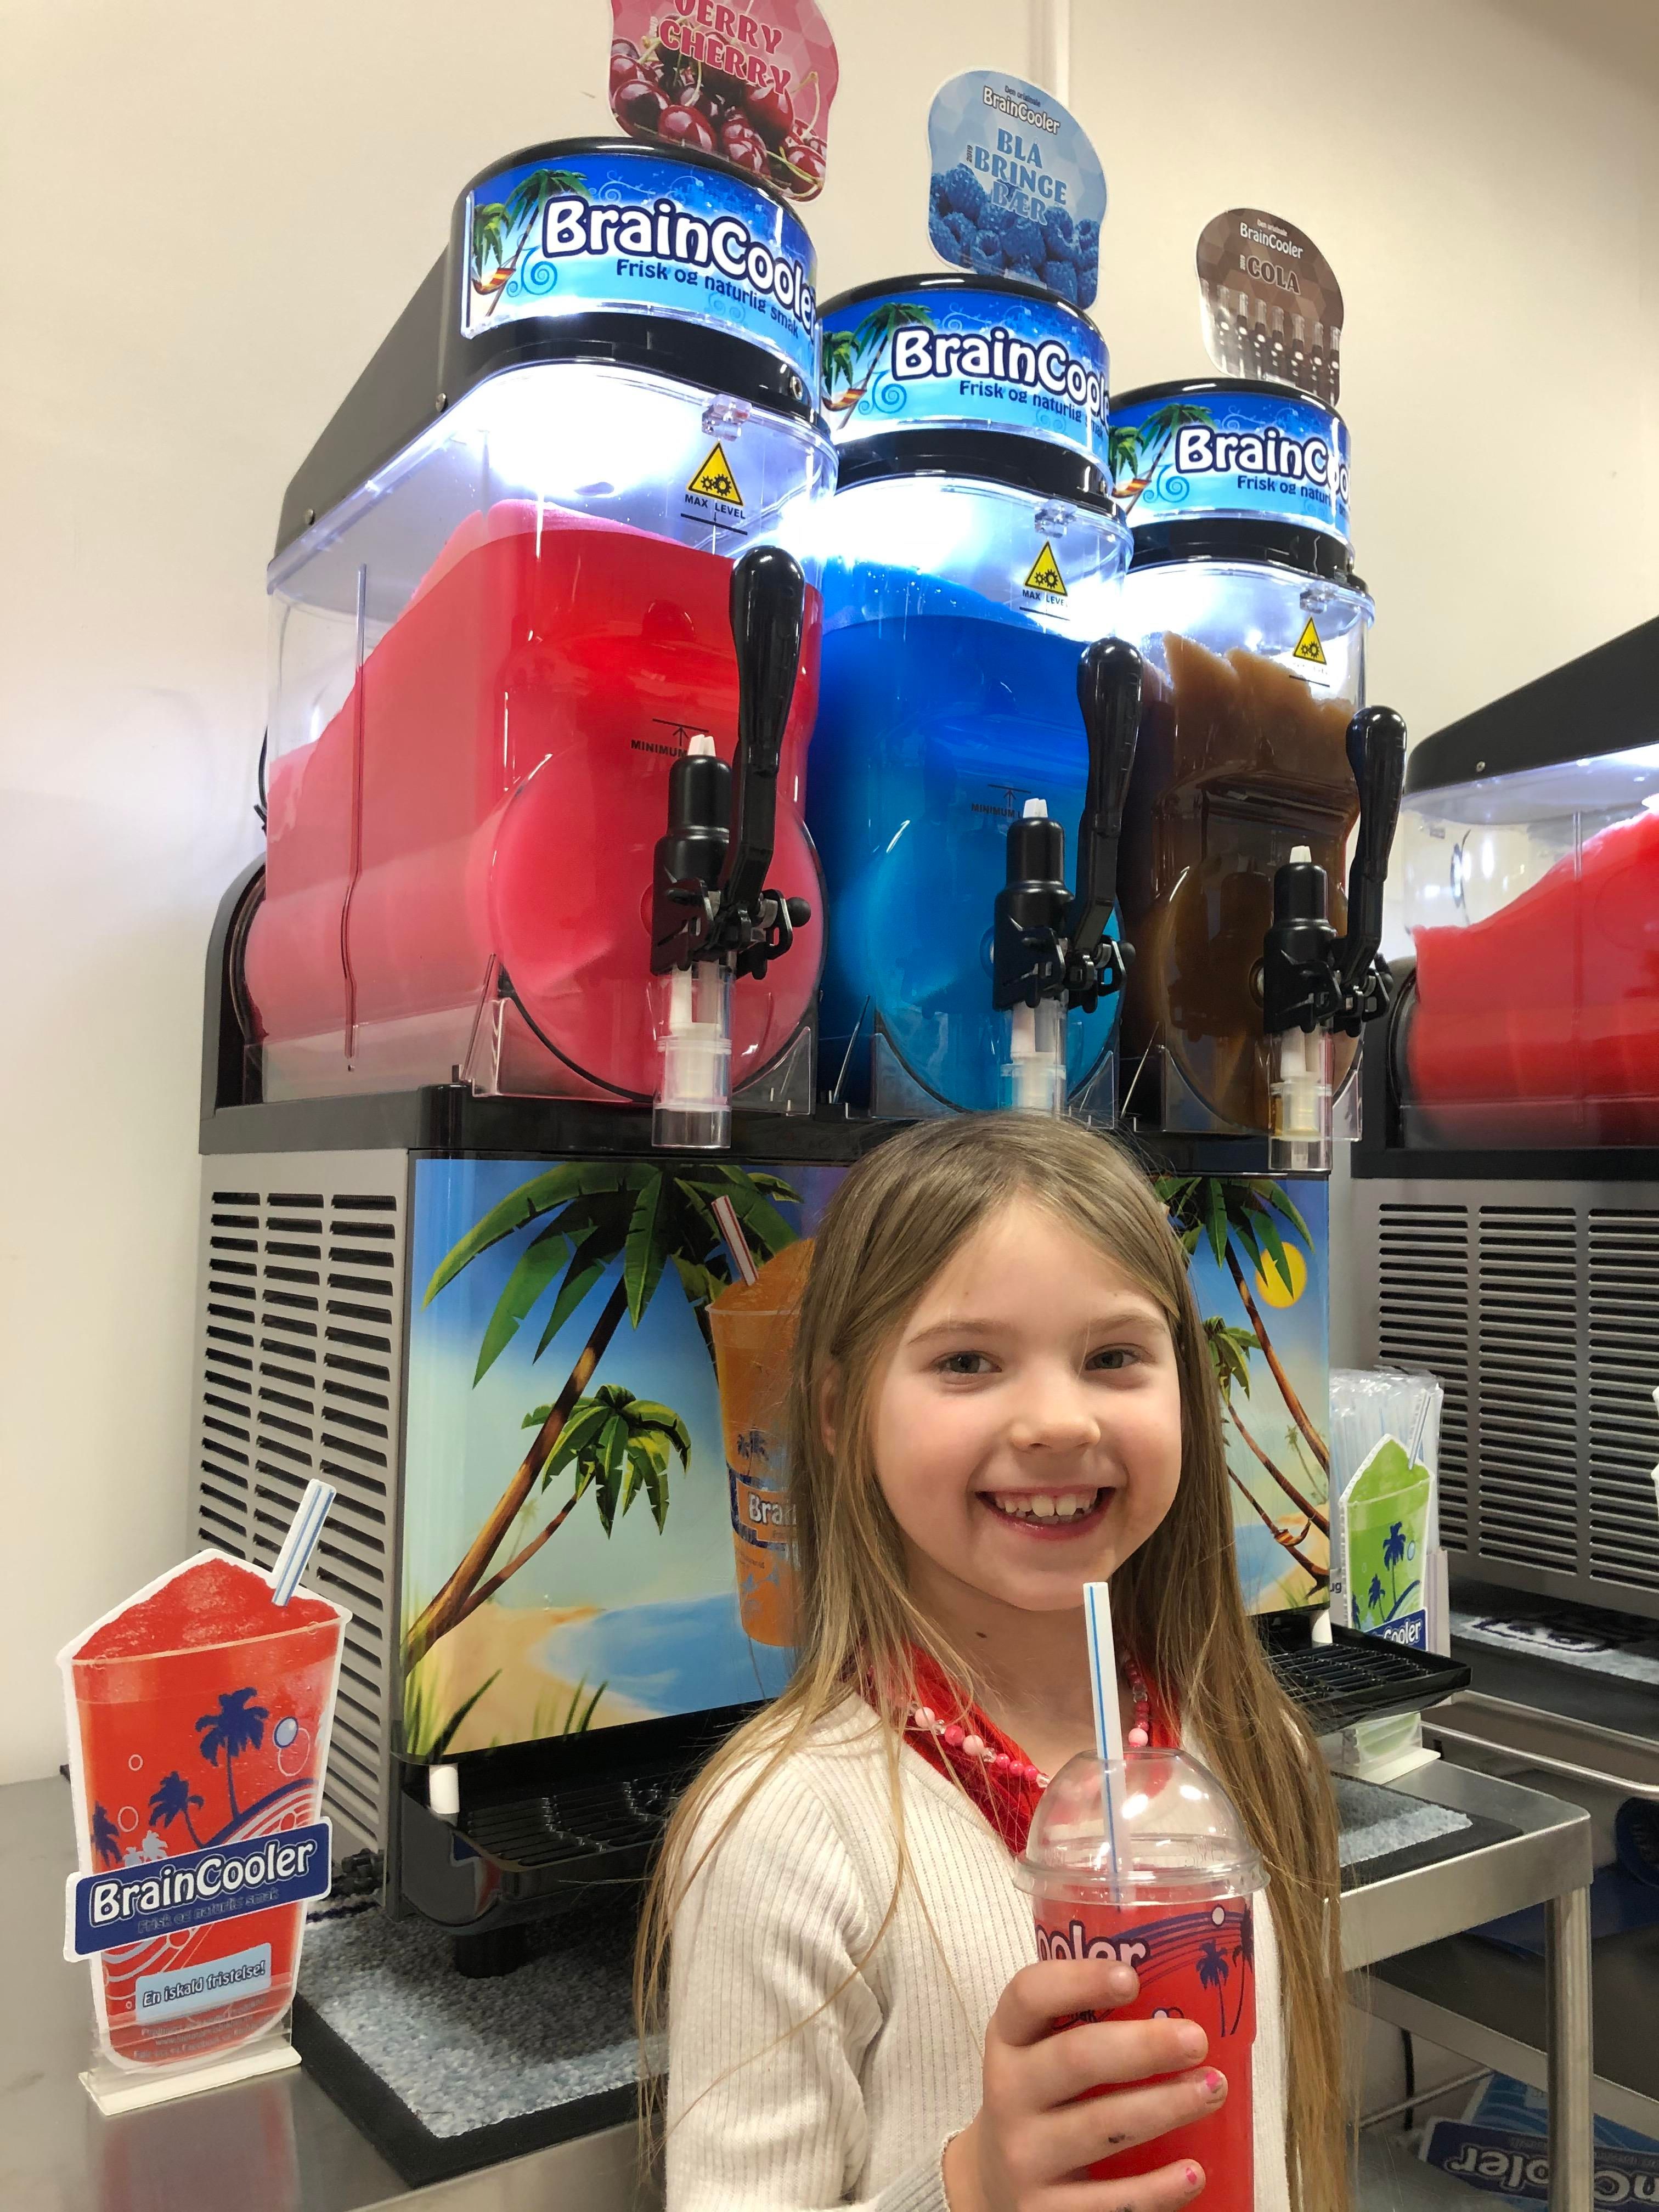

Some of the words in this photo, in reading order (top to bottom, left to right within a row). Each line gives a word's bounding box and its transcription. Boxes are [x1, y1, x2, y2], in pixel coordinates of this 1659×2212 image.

[659, 19, 792, 95] CHERRY
[983, 85, 1060, 136] BrainCooler
[992, 180, 1047, 225] BÆR
[1239, 222, 1304, 259] BrainCooler
[1246, 255, 1301, 295] COLA
[616, 258, 668, 281] Frisk
[674, 267, 698, 286] og
[704, 275, 766, 313] naturlig
[770, 306, 799, 340] smak
[960, 380, 1003, 399] Frisk
[1008, 389, 1028, 404] og
[1032, 393, 1082, 424] naturlig
[1237, 475, 1276, 492] Frisk
[1280, 481, 1296, 495] og
[685, 494, 708, 509] MAX
[715, 503, 746, 520] LEVEL
[1022, 589, 1041, 601] MAX
[1046, 593, 1068, 607] LEVE
[631, 740, 688, 758] MINIMUM
[971, 803, 1014, 817] MINIMUM
[89, 1839, 318, 1927] BrainCooler
[143, 1990, 161, 2008] En
[164, 1977, 204, 2002] iskald
[206, 1960, 266, 1990] fristelse!
